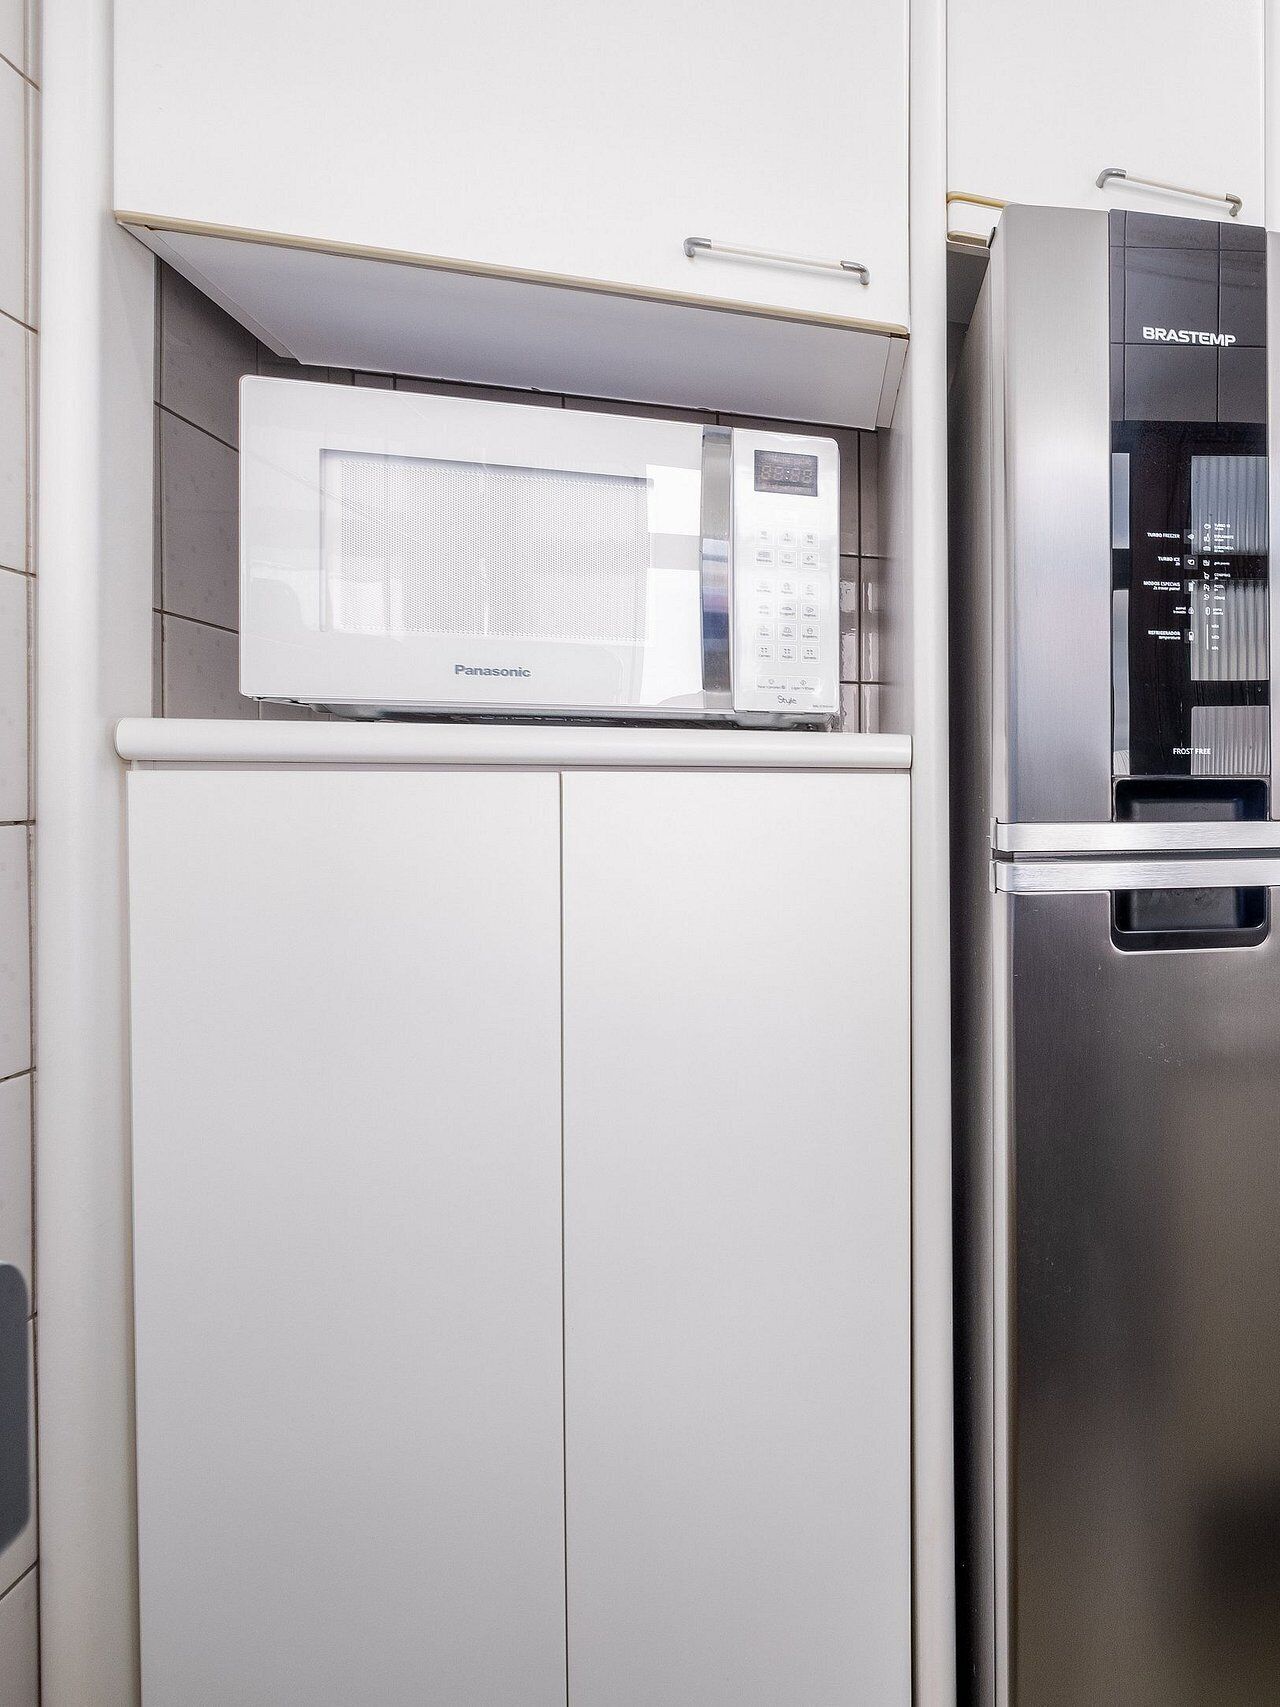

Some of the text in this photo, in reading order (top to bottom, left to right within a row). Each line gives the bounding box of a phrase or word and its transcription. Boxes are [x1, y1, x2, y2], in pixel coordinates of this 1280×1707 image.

[1142, 326, 1237, 347] BRASTEMP
[454, 664, 533, 678] Panasonic
[777, 694, 798, 706] Style
[1172, 747, 1212, 755] FROST FREE
